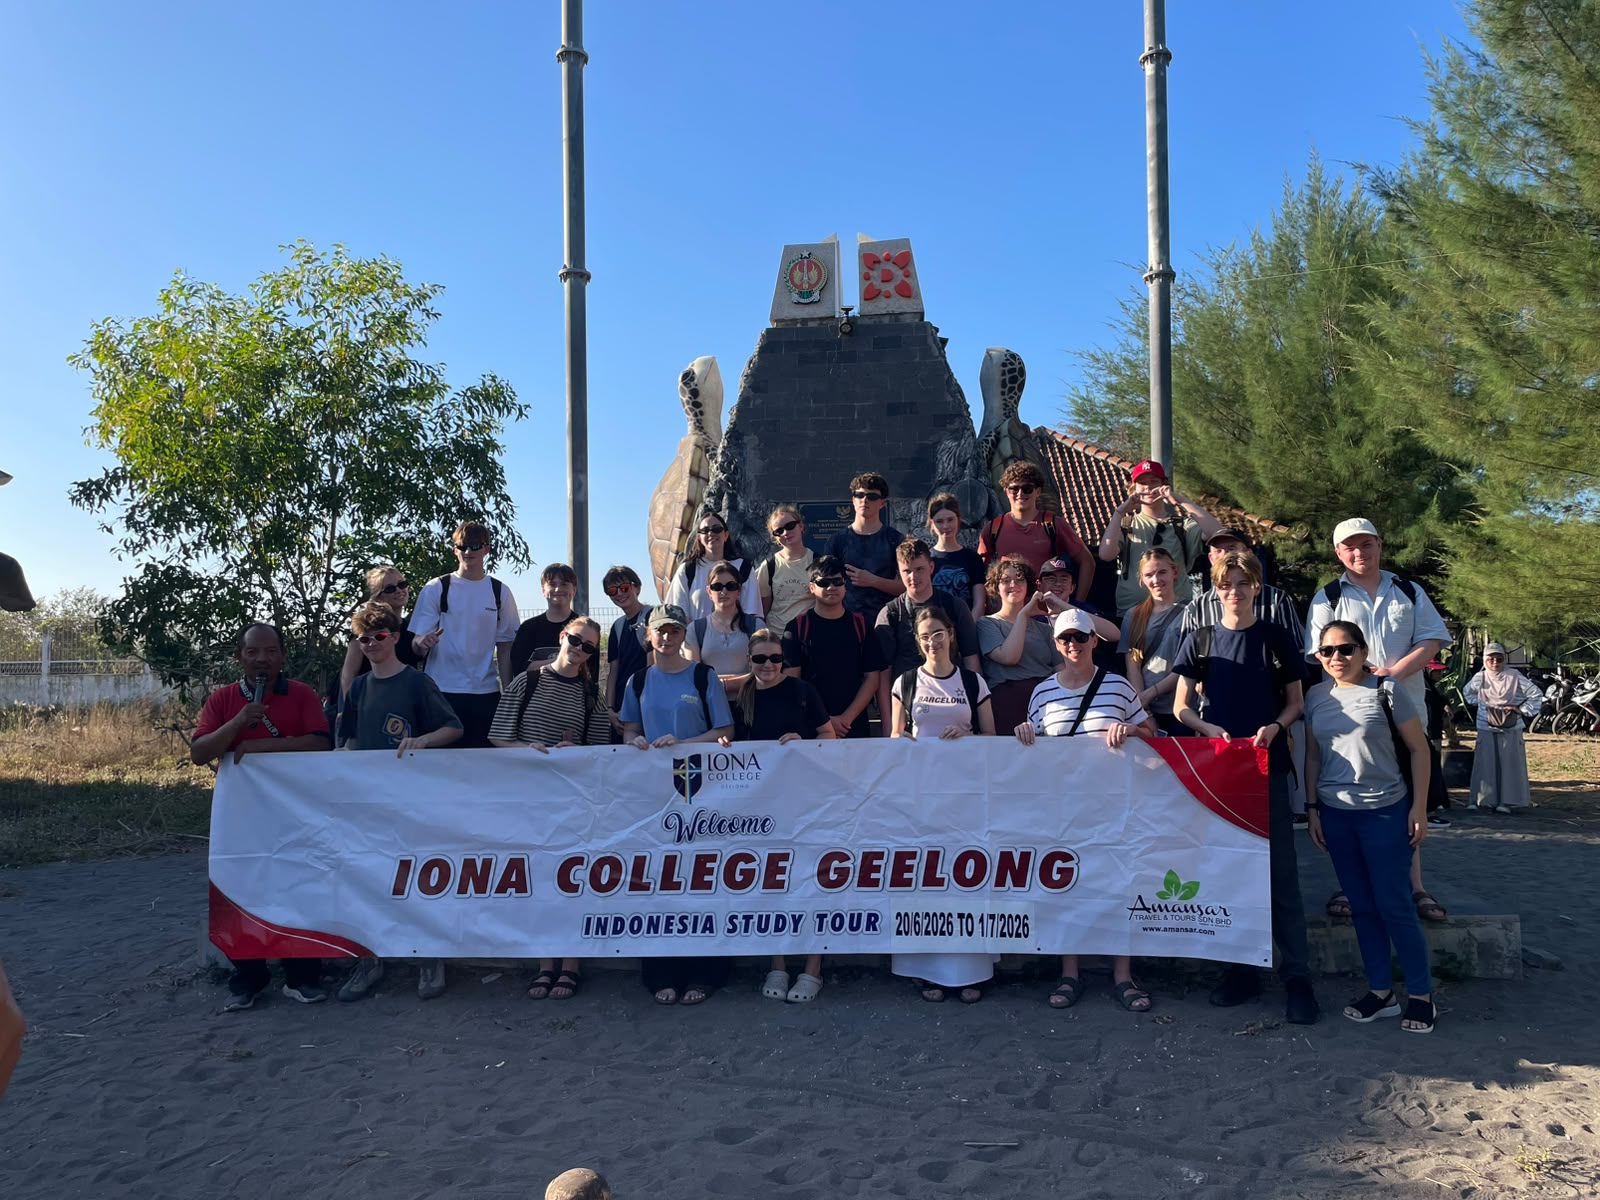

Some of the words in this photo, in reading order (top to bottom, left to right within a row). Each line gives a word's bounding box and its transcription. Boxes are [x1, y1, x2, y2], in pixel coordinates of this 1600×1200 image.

[918, 696, 967, 704] BARCELONA
[708, 753, 762, 771] IONA
[708, 772, 760, 781] COLLEGE
[663, 808, 775, 844] Welcome
[391, 854, 532, 898] IONA
[555, 849, 794, 897] COLLEGE
[815, 847, 1080, 893] GEELONG
[1126, 894, 1232, 920] Amansar
[581, 911, 717, 938] INDONESIA
[726, 910, 803, 937] STUDY
[815, 909, 882, 934] TOUR
[895, 911, 954, 937] 20/6/2026
[957, 912, 975, 937] TO
[978, 913, 1030, 939] 1/7/2026
[1170, 914, 1196, 922] TOURS
[1142, 926, 1216, 936] www.amansar.com
